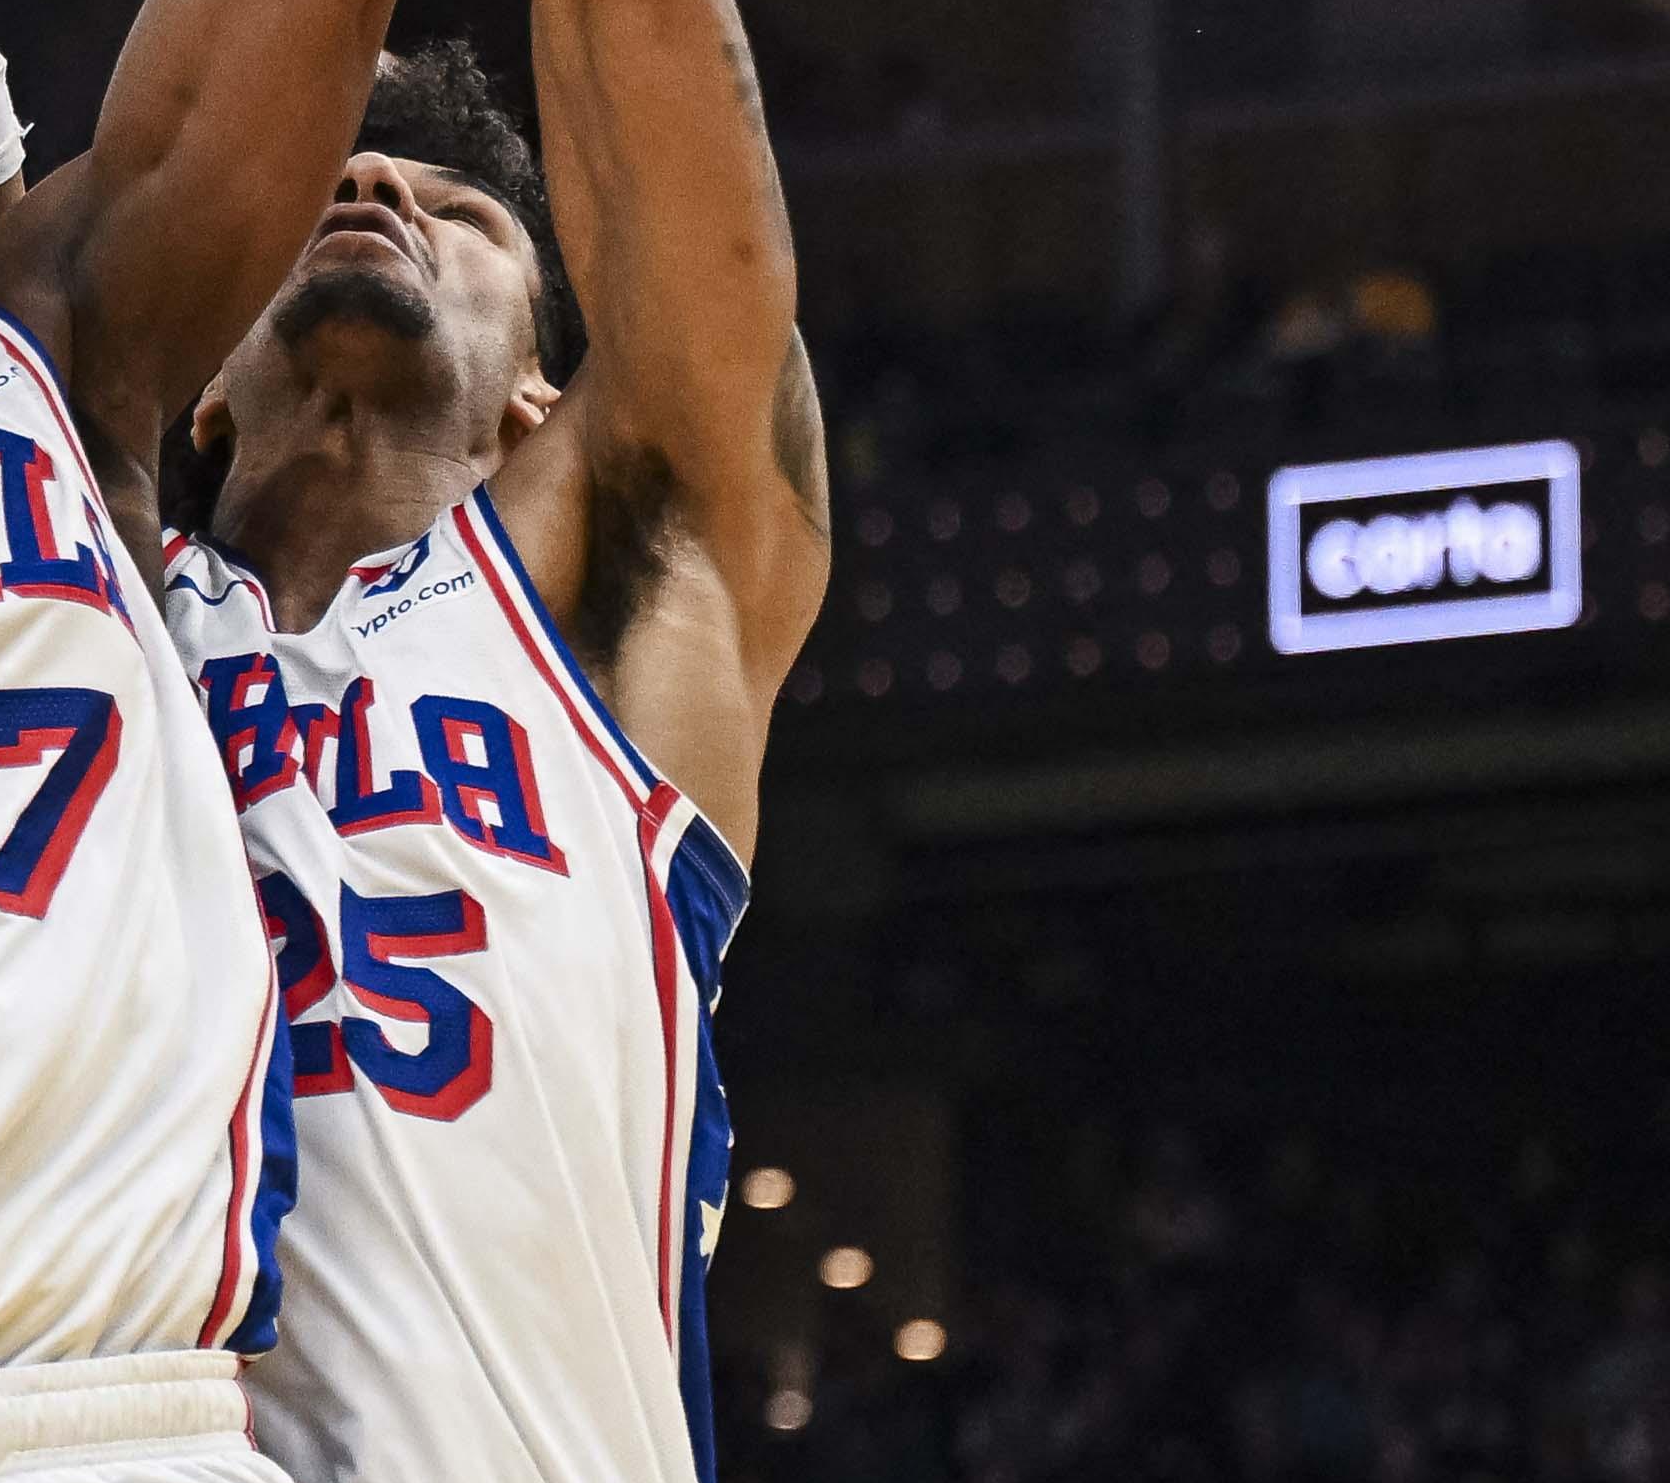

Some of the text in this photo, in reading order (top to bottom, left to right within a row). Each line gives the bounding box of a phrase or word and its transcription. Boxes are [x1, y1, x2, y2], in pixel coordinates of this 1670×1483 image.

[1306, 497, 1542, 599] carta
[351, 571, 475, 638] ypto.com
[199, 652, 569, 877] HILA
